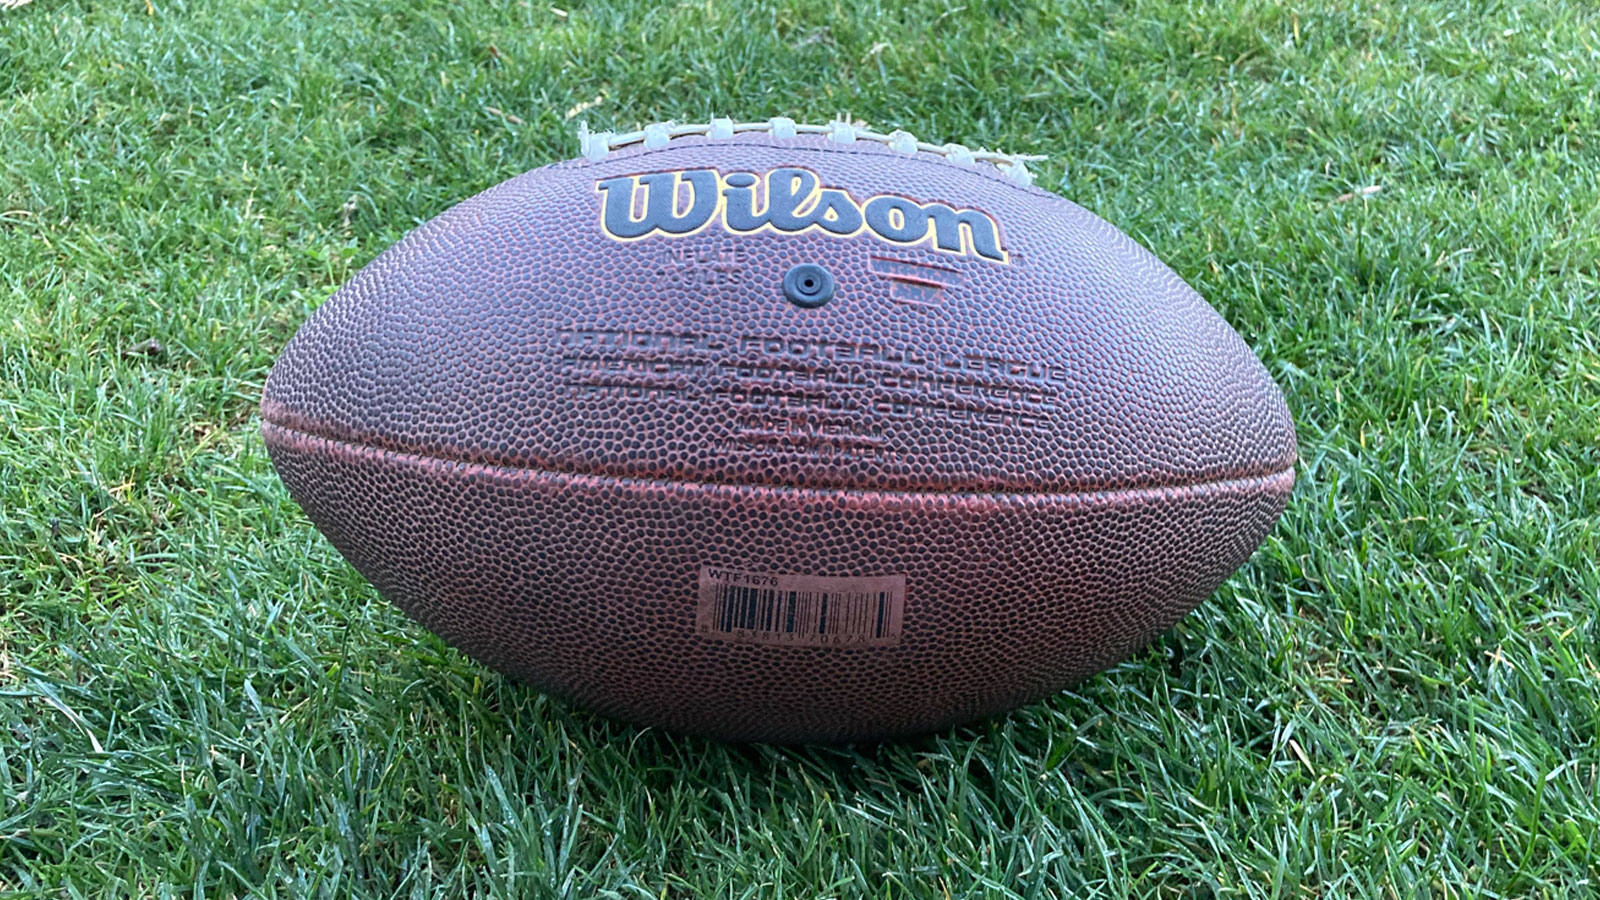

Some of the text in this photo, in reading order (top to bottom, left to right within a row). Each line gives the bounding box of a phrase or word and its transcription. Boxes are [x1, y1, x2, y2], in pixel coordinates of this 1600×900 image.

[595, 166, 1009, 266] Wilson
[550, 329, 1068, 381] NATIONAL FOOTBALL LEAGUE
[708, 568, 778, 587] WTF1676
